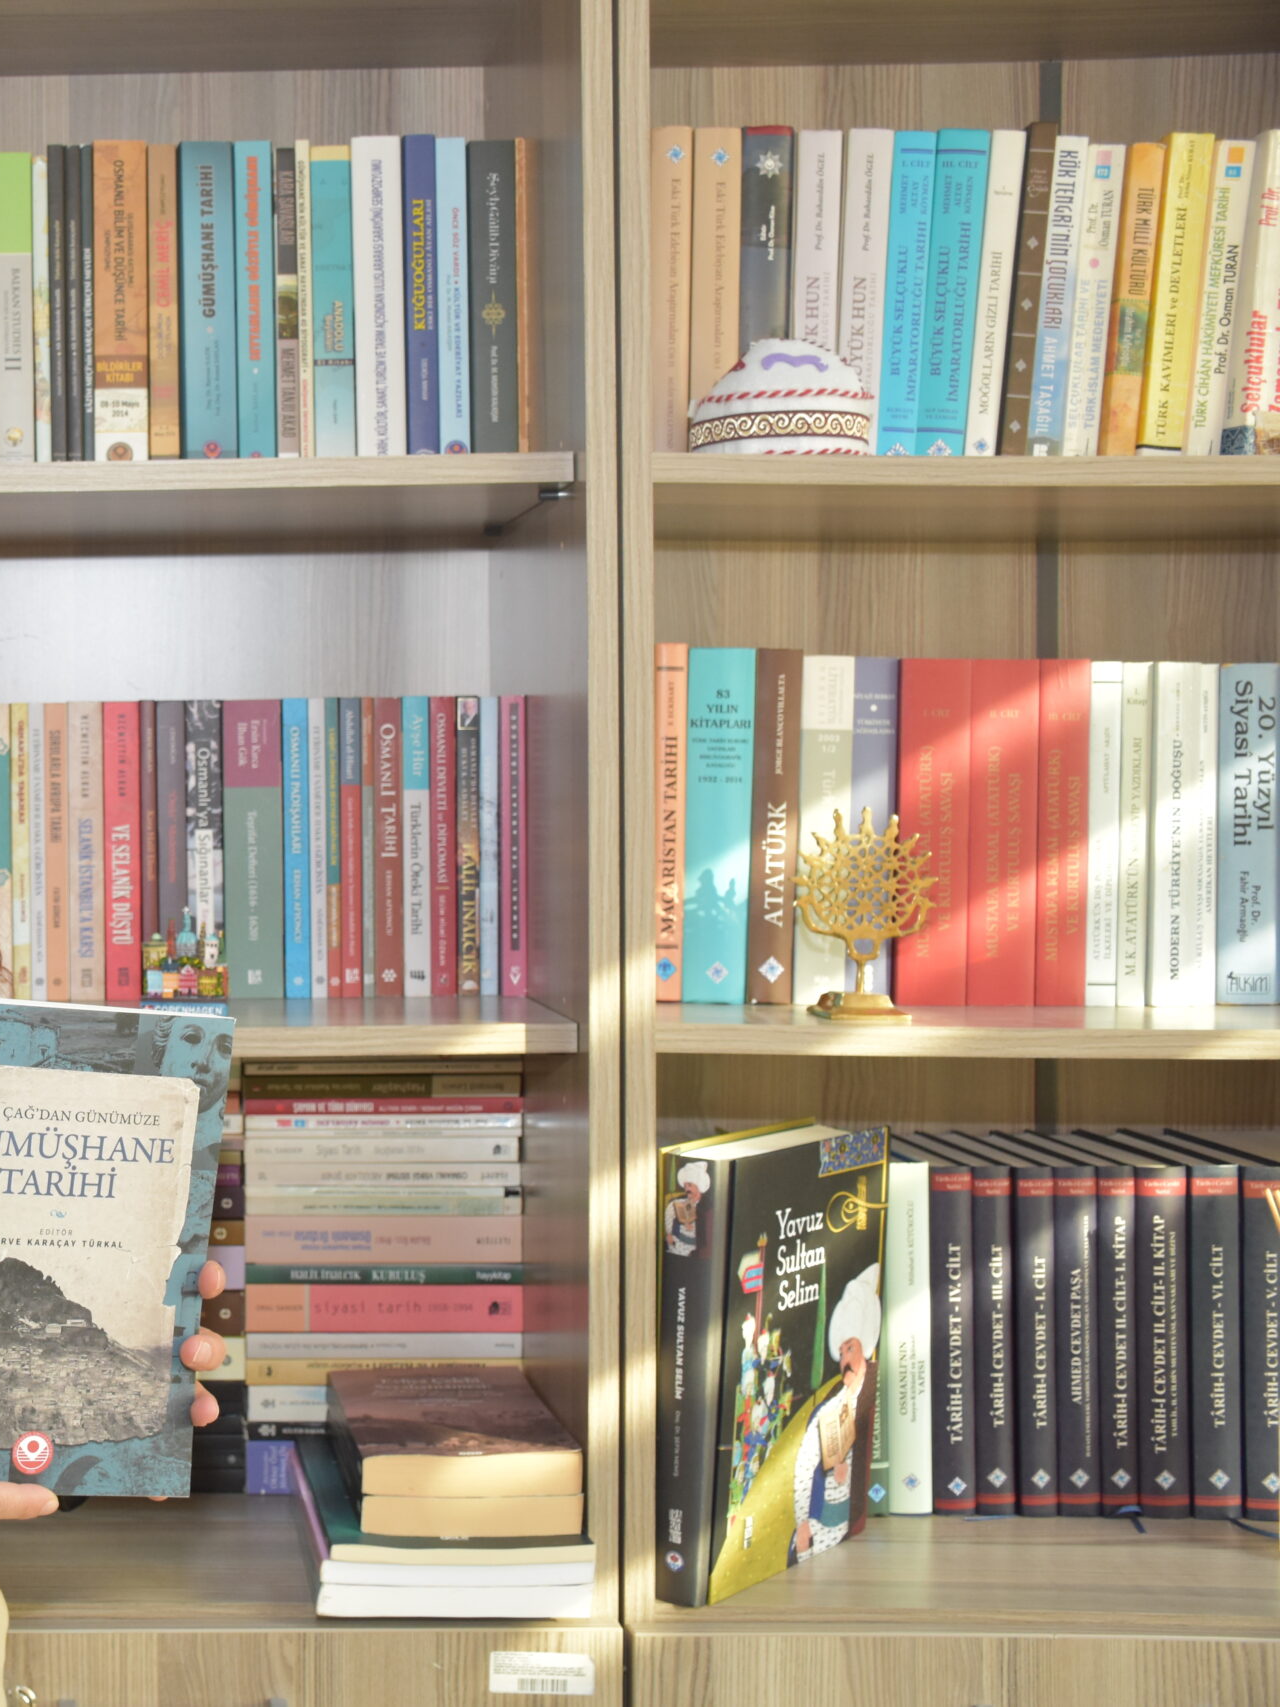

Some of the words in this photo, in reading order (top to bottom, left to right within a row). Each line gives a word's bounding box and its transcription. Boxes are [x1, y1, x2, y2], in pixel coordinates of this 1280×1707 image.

[112, 159, 125, 208] OSMANLI
[197, 164, 214, 218] TARİHİ
[1211, 186, 1231, 224] TARİHİ
[113, 209, 127, 239] BİLİM
[114, 240, 126, 256] VE
[153, 220, 173, 264] MERİÇ
[911, 220, 928, 273] TARİHİ
[953, 220, 972, 273] TARİHİ
[197, 222, 216, 319] GÜMÜŞHANE
[411, 199, 426, 331] KUĞUOĞULLARI
[985, 250, 1004, 293] TARİHİ
[1168, 206, 1189, 295] DEVLETLERİ
[1205, 225, 1227, 290] MEFKÛRESİ
[1223, 243, 1240, 285] TURAN
[111, 256, 128, 305] DÜŞÜNCE
[153, 265, 171, 308] CEMİL
[804, 276, 820, 320] HUN
[892, 244, 910, 324] SELÇUKLU
[932, 245, 952, 324] SELÇUKLU
[1168, 296, 1178, 311] ve
[113, 306, 128, 341] TARİHİ
[982, 294, 1000, 330] GİZLİ
[1198, 290, 1219, 357] HÂKİMİYETİ
[1218, 286, 1235, 328] Osman
[888, 325, 905, 377] BÜYÜK
[903, 275, 925, 403] İMPARATORLUĞU
[927, 325, 946, 377] BÜYÜK
[945, 274, 969, 403] İMPARATORLUĞU
[1039, 334, 1059, 380] AHMET
[1157, 312, 1178, 394] KAVİMLERİ
[1213, 348, 1228, 376] Prof.
[1216, 329, 1230, 346] Dr.
[1239, 309, 1269, 415] Selçuklular
[976, 330, 995, 416] MOĞOLLARIN
[1194, 358, 1212, 398] CİHÂN
[110, 408, 130, 418] 2014
[1034, 383, 1056, 436] TAŞAĞIL
[1153, 399, 1170, 439] TÜRK
[1193, 400, 1209, 430] TÜRK
[706, 703, 739, 714] YILIN
[715, 689, 731, 700] 83
[1257, 695, 1278, 739] 20.
[435, 712, 448, 765] OSMANLI
[690, 717, 752, 729] KİTAPLARI
[1232, 679, 1255, 760] Siyasî
[288, 725, 302, 780] OSMANLI
[378, 722, 397, 797] OSMANLI
[660, 734, 679, 806] TARİHİ
[1128, 736, 1143, 801] YAZDIKLARI
[1169, 738, 1185, 801] DOĞUŞU
[194, 746, 212, 828] Osmanlı'ya
[435, 765, 449, 812] DEVLETİ
[939, 771, 955, 823] SAVAŞI
[986, 745, 1004, 827] (ATATÜRK)
[1007, 772, 1023, 824] SAVAŞI
[1046, 748, 1062, 830] (ATATÜRK)
[1066, 775, 1083, 827] SAVAŞI
[1233, 768, 1255, 847] Tarihi
[1253, 750, 1276, 832] Yüzyıl
[76, 817, 94, 862] SELANİK
[112, 823, 135, 842] VE
[288, 780, 303, 855] PADİŞAHLARI
[380, 803, 399, 859] TARİHİ
[408, 802, 422, 860] Türklerin
[111, 843, 135, 901] SELANİK
[196, 833, 212, 905] Sığınanlar
[435, 822, 449, 884] DİPLOMASİ
[658, 808, 678, 937] MACARİSTAN
[761, 800, 788, 929] ATATÜRK
[938, 826, 955, 908] KURTULUŞ
[986, 830, 1001, 884] KEMAL
[1006, 827, 1022, 908] KURTULUŞ
[1045, 835, 1060, 887] KEMAL
[1066, 829, 1082, 912] KURTULUŞ
[1168, 806, 1183, 909] TÜRKİYE'NİN
[77, 863, 96, 924] İSTANBUL'A
[409, 861, 424, 897] Öteki
[1237, 869, 1250, 894] Fahir
[1250, 884, 1262, 907] Prof.
[109, 902, 135, 947] DÜŞTÜ
[410, 900, 423, 936] Tarihi
[939, 911, 953, 931] VE
[985, 886, 1000, 958] MUSTAFA
[1006, 912, 1020, 932] VE
[1045, 889, 1060, 961] MUSTAFA
[1066, 915, 1080, 936] VE
[1236, 895, 1250, 943] Armaoğlu
[1250, 909, 1262, 926] Dr.
[76, 926, 94, 960] KARŞI
[1167, 914, 1182, 981] MODERN
[2, 1104, 72, 1123] ÇAĞ'DAN
[74, 1108, 161, 1127] GÜNÜMÜZE
[26, 1238, 77, 1249] KARAÇAY
[81, 1238, 124, 1249] TÜRKAL
[38, 1227, 74, 1236] EDİTÖR
[775, 1206, 825, 1241] Yavuz
[371, 1268, 426, 1284] KURULUŞ
[775, 1238, 826, 1277] Sultan
[944, 1242, 962, 1281] CİLT
[987, 1243, 1003, 1279] CİLT
[1031, 1255, 1046, 1291] CİLT
[1208, 1243, 1225, 1279] CİLT
[313, 1300, 365, 1317] siyasi
[376, 1300, 423, 1314] tarih
[676, 1286, 687, 1322] YAVUZ
[777, 1273, 820, 1312] Selim
[947, 1282, 962, 1304] IV.
[990, 1279, 1004, 1301] III.
[1033, 1291, 1047, 1301] I.
[1069, 1268, 1084, 1301] PAŞA
[1212, 1279, 1225, 1301] VI.
[674, 1323, 686, 1366] SULTAN
[948, 1314, 963, 1380] CEVDET
[991, 1309, 1005, 1370] CEVDET
[1033, 1311, 1048, 1370] CEVDET
[1069, 1301, 1083, 1356] CEVDET
[1211, 1310, 1226, 1370] CEVDET
[674, 1366, 686, 1401] SELİM
[916, 1359, 926, 1396] YAPISI
[1070, 1355, 1083, 1406] AHMED
